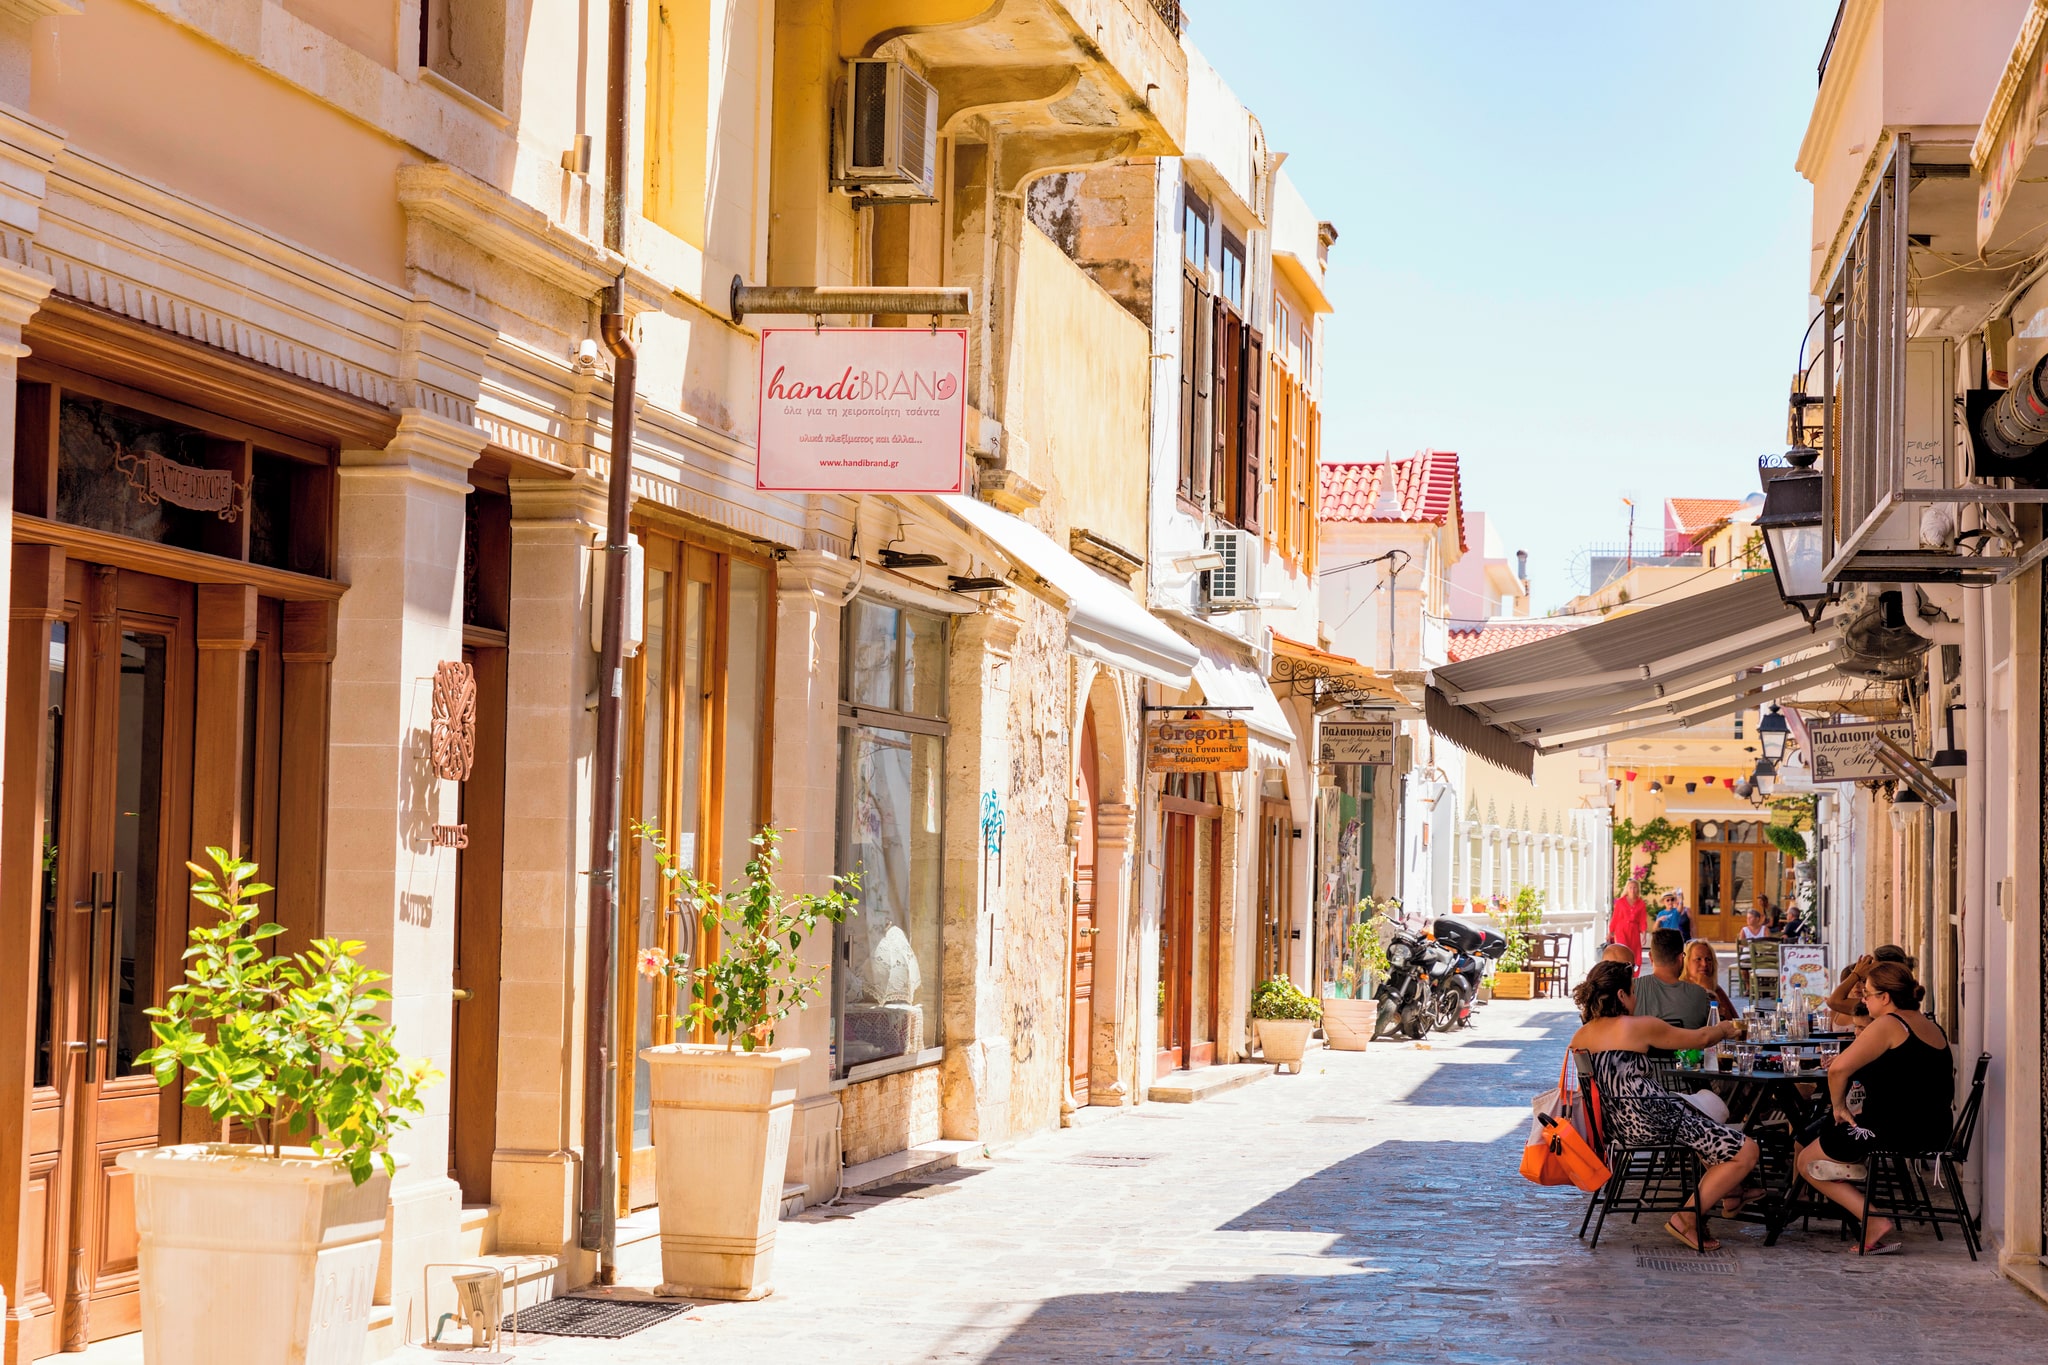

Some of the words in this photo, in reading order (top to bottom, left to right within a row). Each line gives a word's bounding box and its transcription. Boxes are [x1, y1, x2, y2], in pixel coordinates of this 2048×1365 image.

[784, 405, 802, 416] όλα
[806, 406, 822, 417] για
[826, 408, 837, 417] τη
[842, 405, 900, 417] χειροποίητη
[905, 406, 940, 416] τσάντα
[819, 459, 899, 468] www.handibrand.gr
[1160, 724, 1234, 745] Gregori
[1322, 726, 1391, 737] Παλαιοπωλείο
[1342, 743, 1370, 760] Shop
[1814, 744, 1850, 757] Antique
[1788, 951, 1820, 959] Pizza
